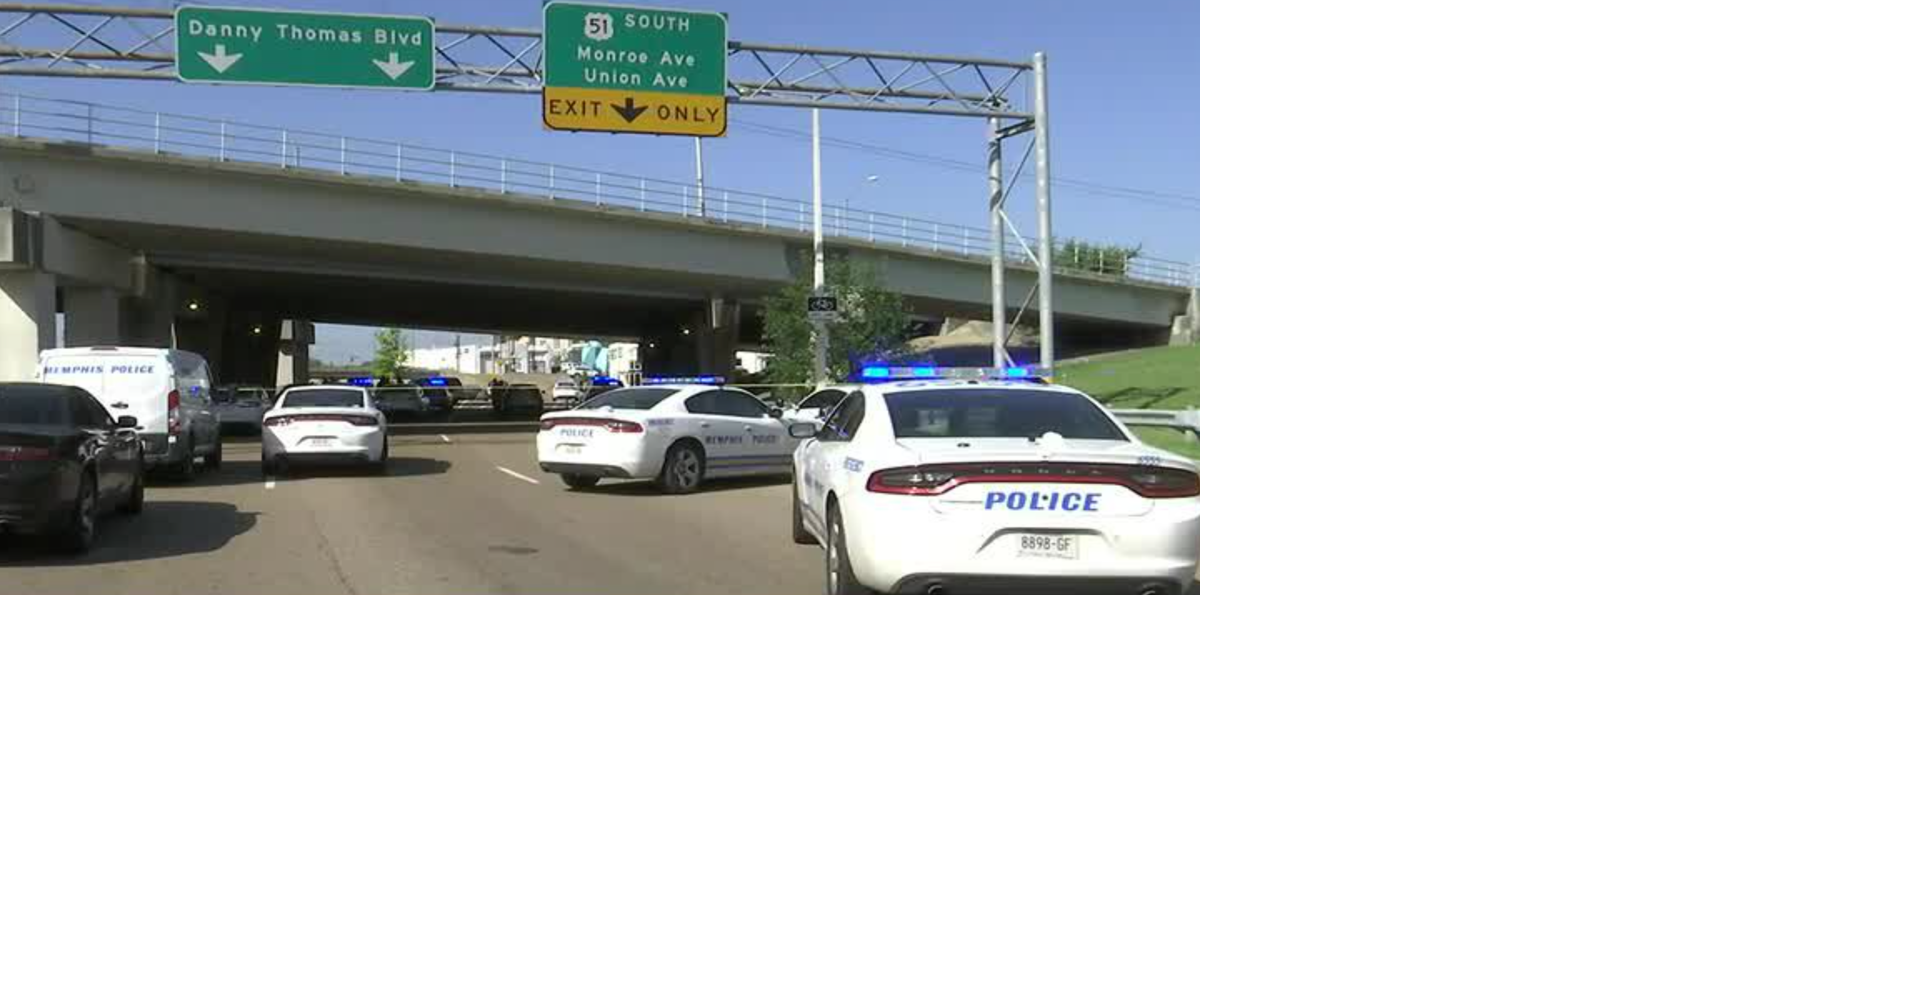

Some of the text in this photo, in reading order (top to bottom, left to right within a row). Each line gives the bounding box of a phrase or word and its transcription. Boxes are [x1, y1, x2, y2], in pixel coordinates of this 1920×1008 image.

[189, 20, 422, 45] Danny Thomas Blvd
[589, 14, 689, 34] 51 SOUTH
[577, 46, 695, 66] Monroe Ave
[584, 68, 688, 88] Union Ave
[549, 99, 719, 123] EXIT ONLY
[43, 365, 155, 374] MEMPHIS POLICE
[560, 428, 594, 438] POLICE
[985, 490, 1102, 511] POLICE
[1021, 535, 1073, 551] 8898-GF
